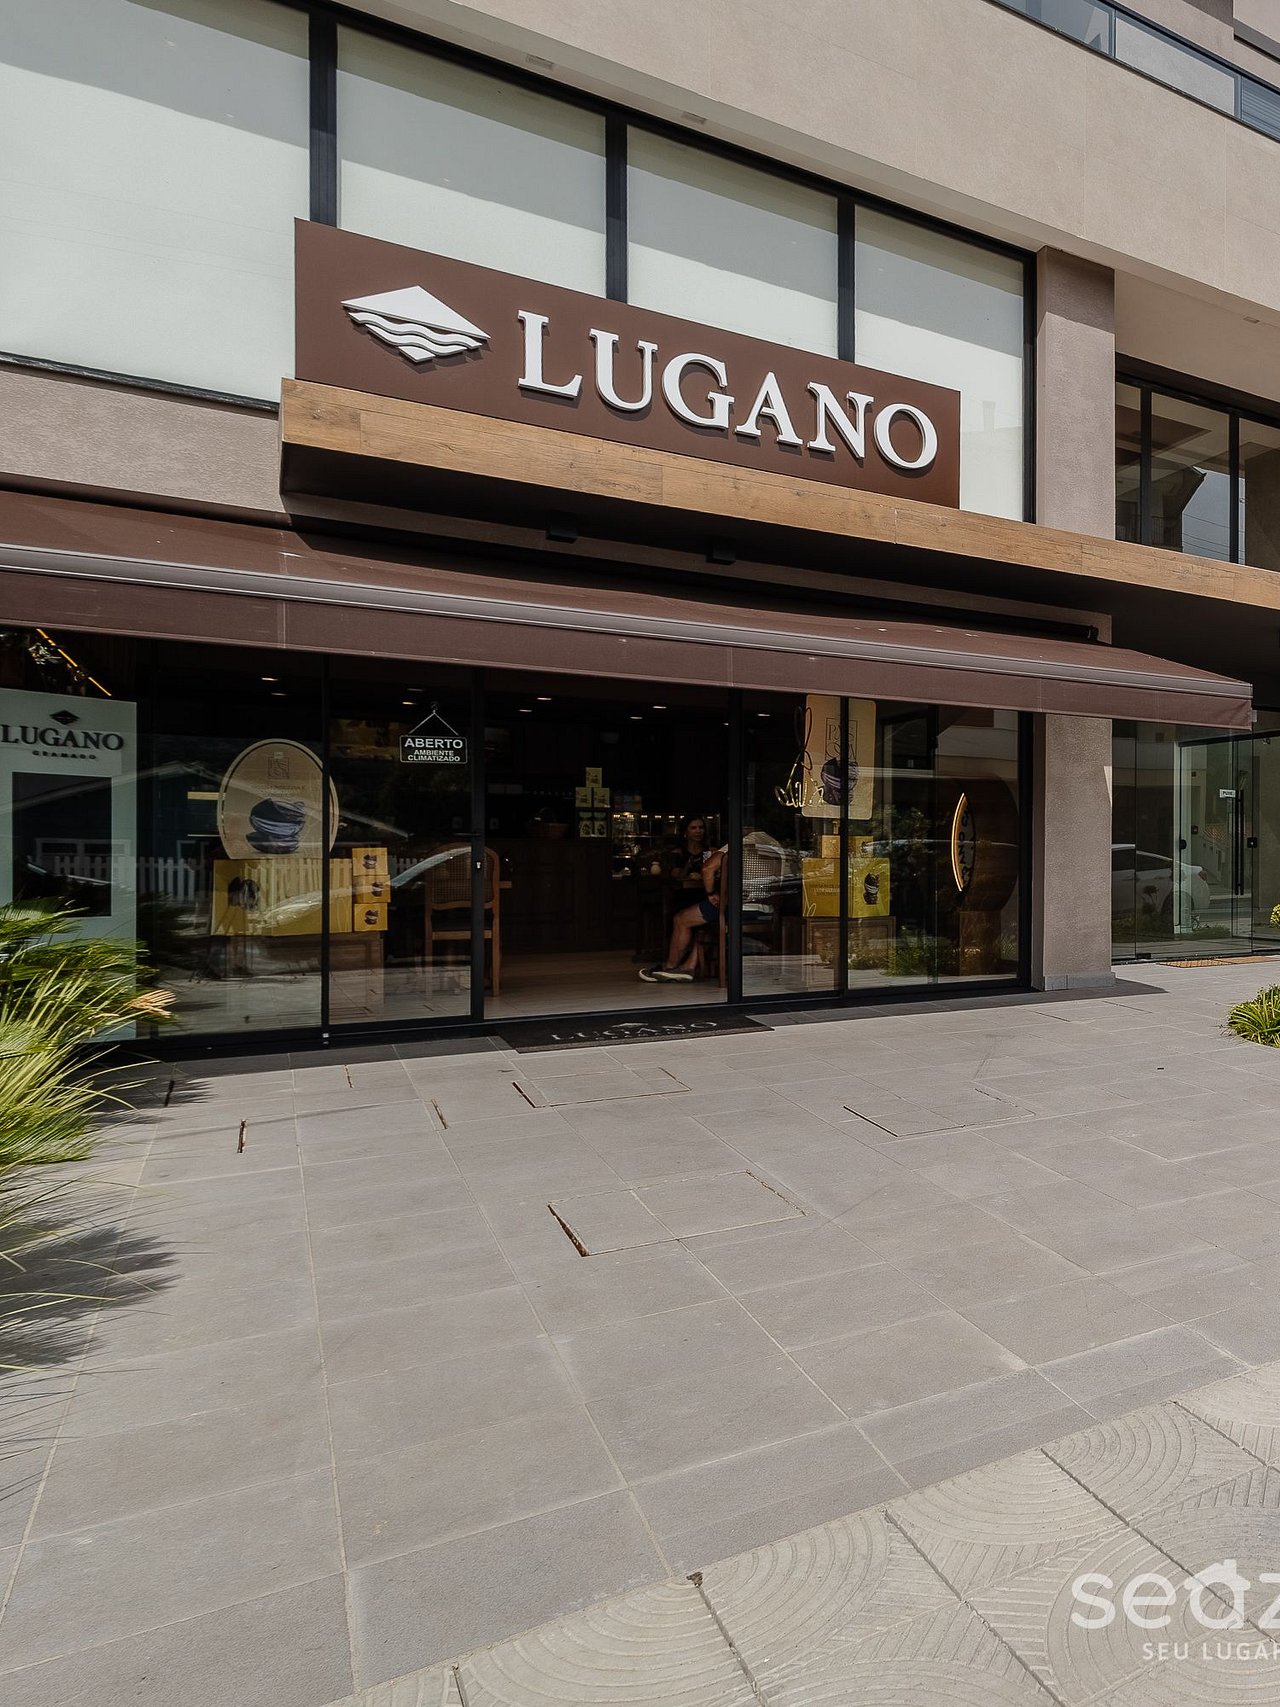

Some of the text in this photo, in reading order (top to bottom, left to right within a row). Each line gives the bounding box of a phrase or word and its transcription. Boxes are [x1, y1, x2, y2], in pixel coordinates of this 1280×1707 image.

[516, 309, 938, 471] LUGANO
[0, 724, 124, 751] LUGANO
[404, 738, 463, 749] ABERTO
[414, 749, 454, 757] AMBIENTE
